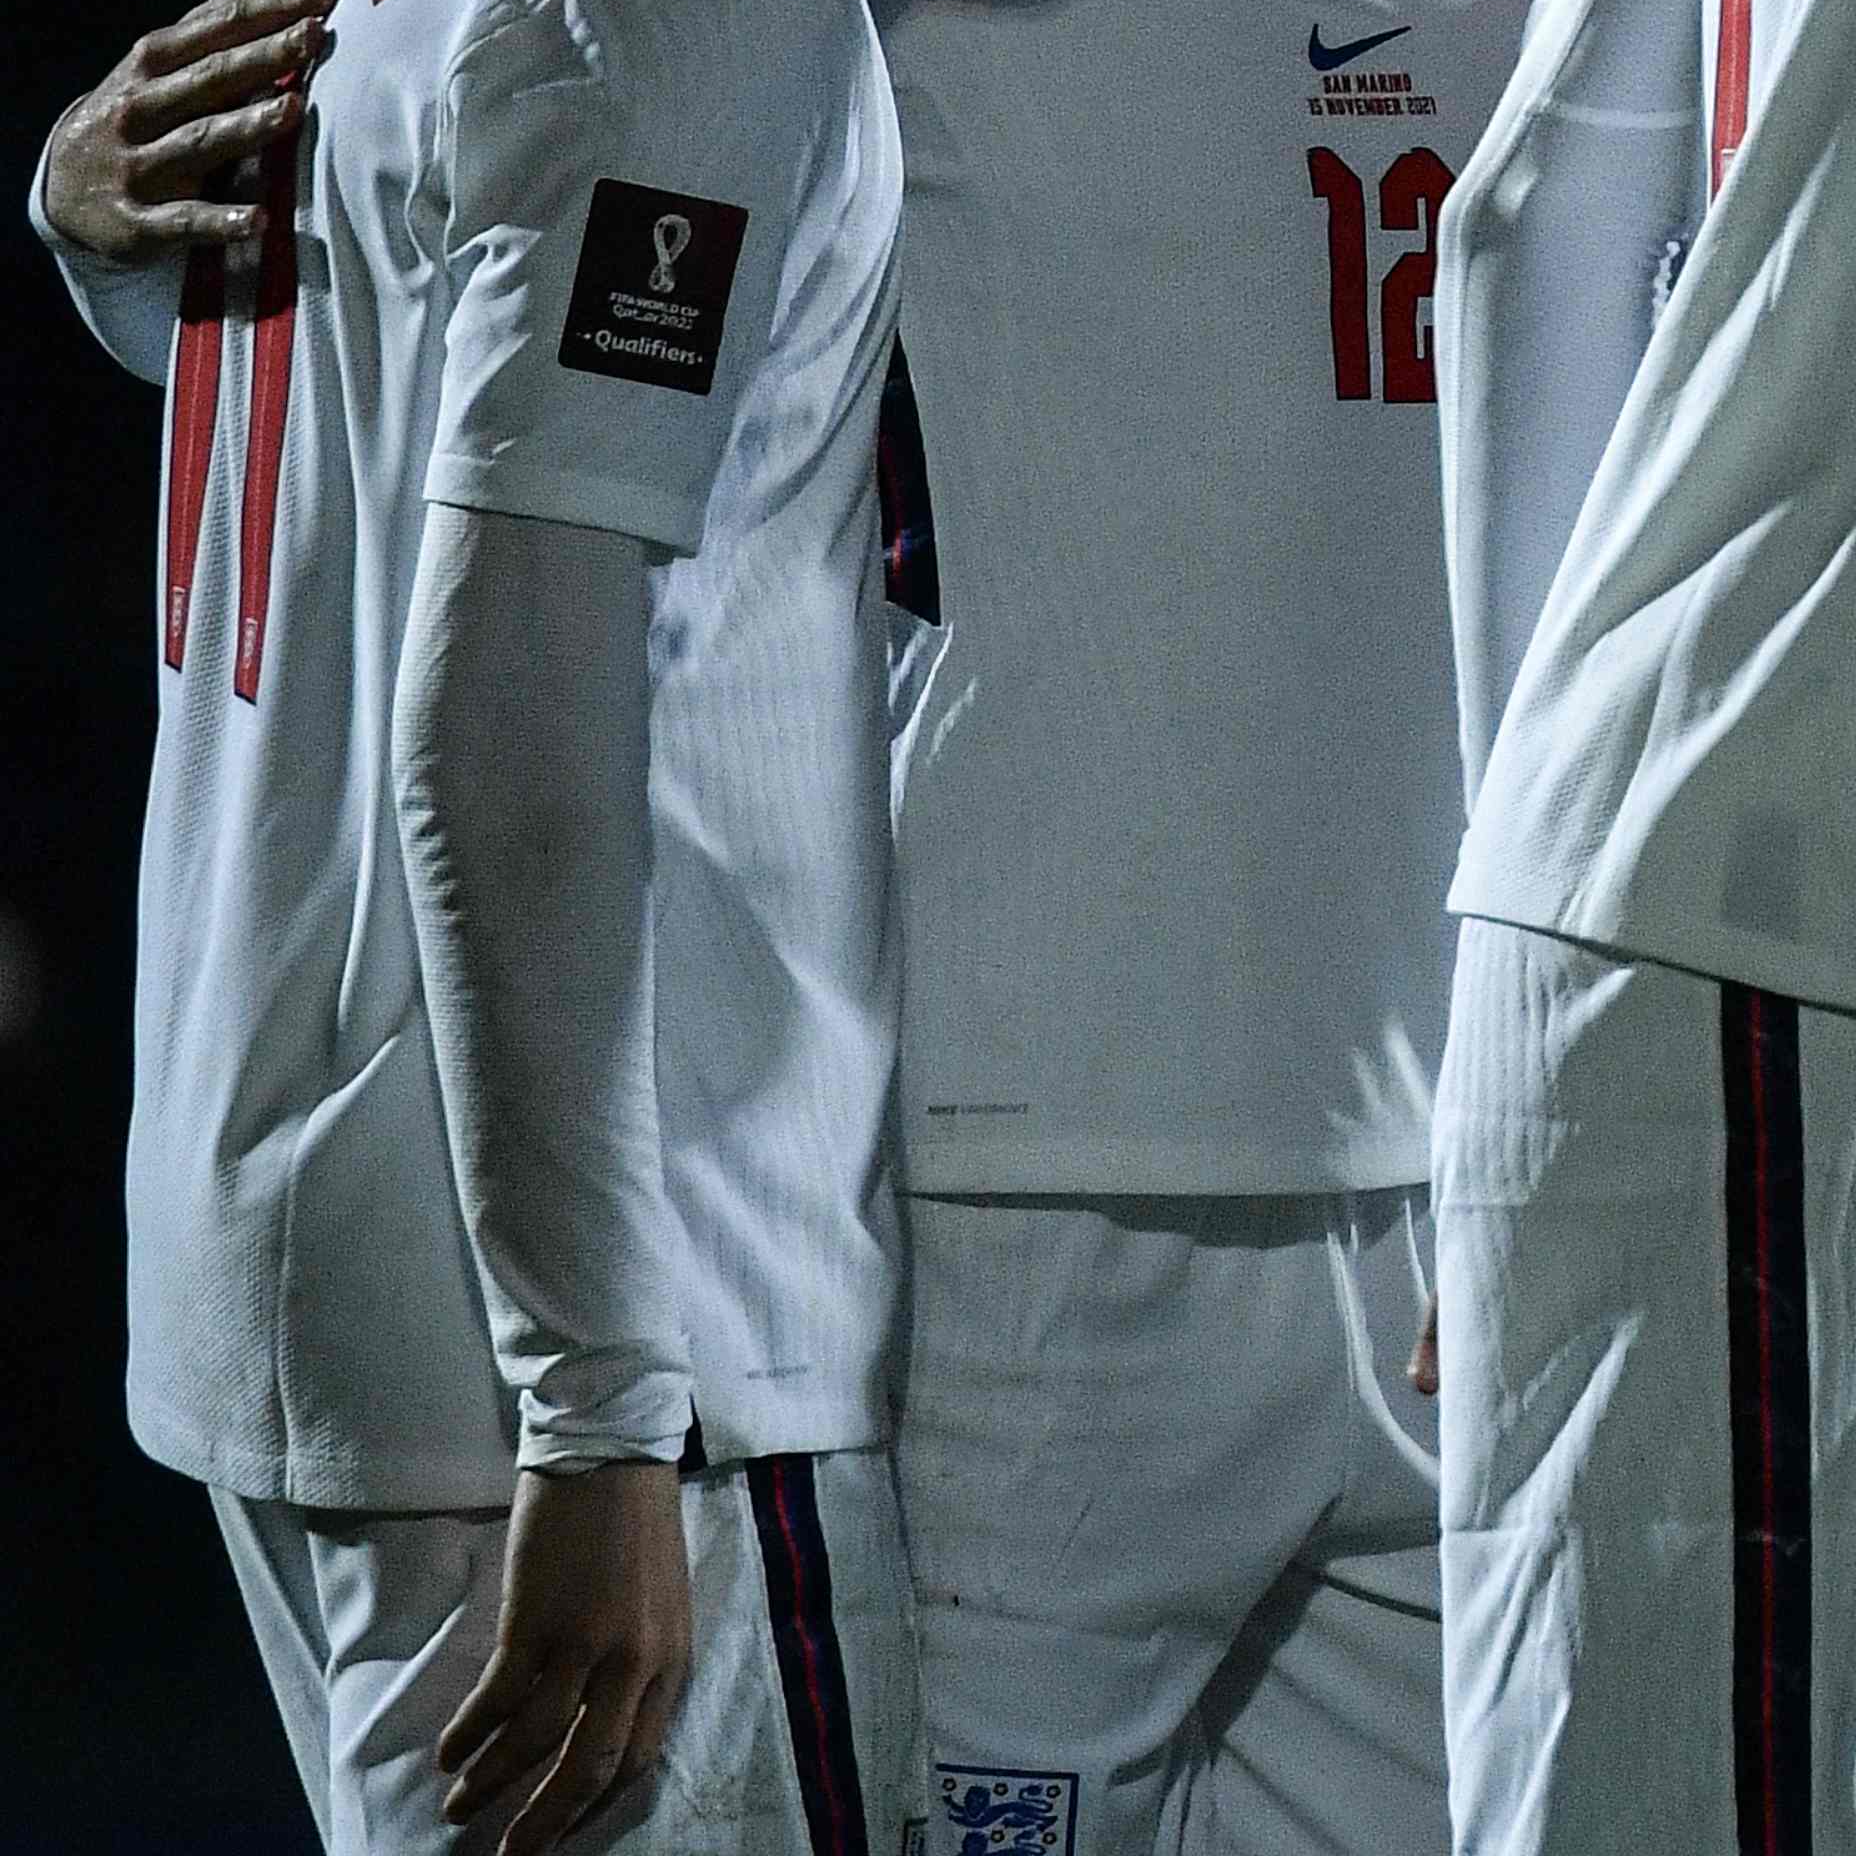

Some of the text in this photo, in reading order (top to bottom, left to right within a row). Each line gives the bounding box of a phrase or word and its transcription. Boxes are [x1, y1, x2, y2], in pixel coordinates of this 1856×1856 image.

[1323, 72, 1413, 94] SAN MARINO
[1307, 146, 1457, 404] 12
[594, 329, 697, 365] Qualifiers
